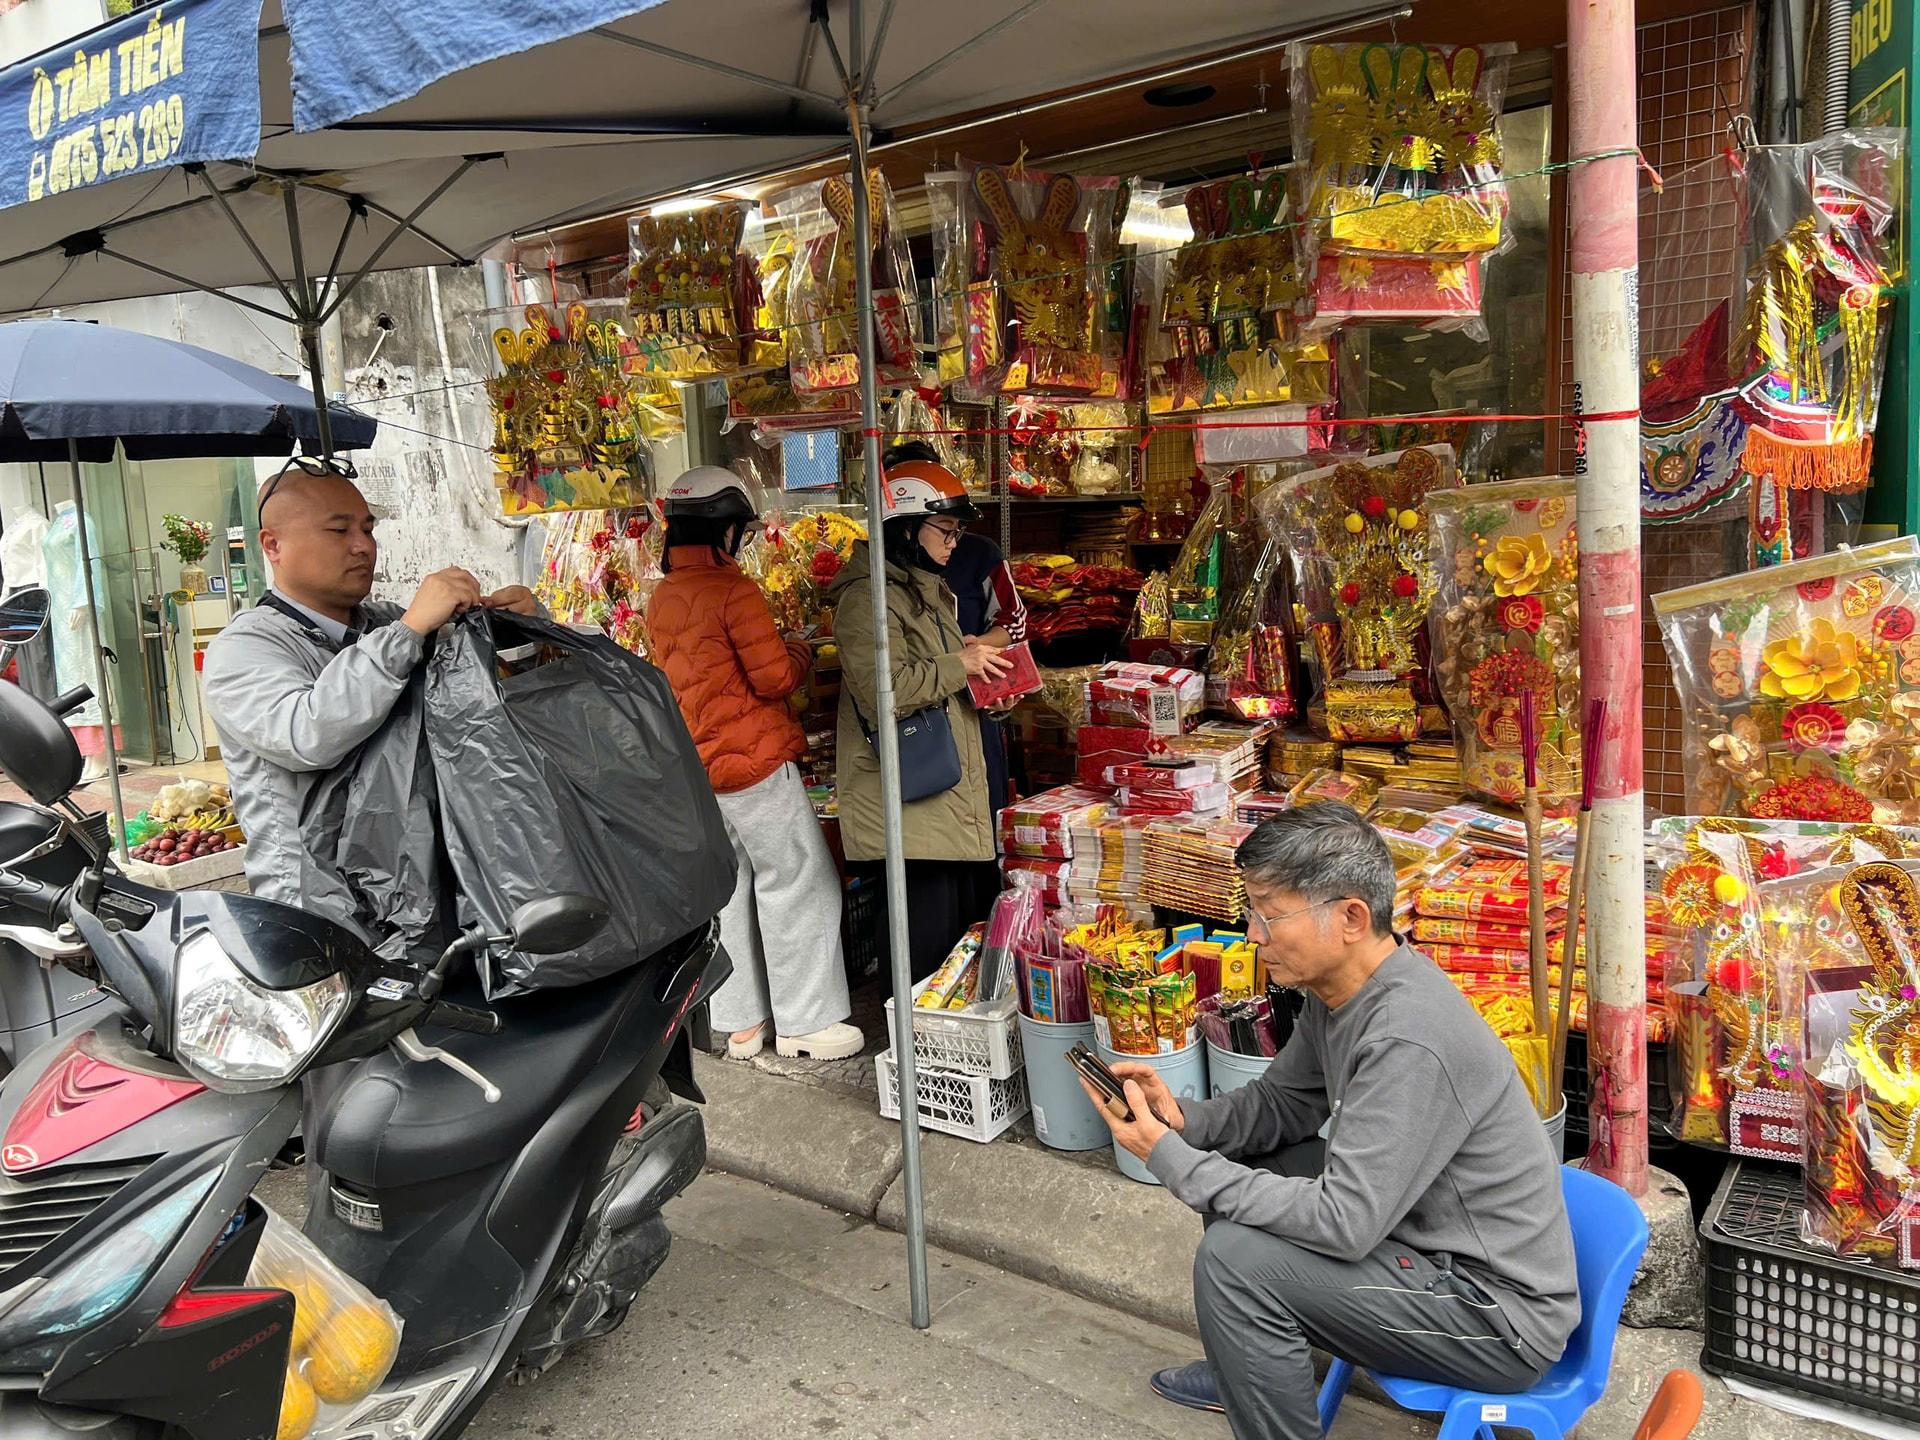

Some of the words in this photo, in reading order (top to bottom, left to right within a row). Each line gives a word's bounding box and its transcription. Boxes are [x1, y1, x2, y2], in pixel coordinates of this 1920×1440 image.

[55, 49, 111, 122] TÂM
[118, 8, 187, 96] TIẾN
[139, 94, 184, 165] 289
[207, 1322, 282, 1372] HONDA
